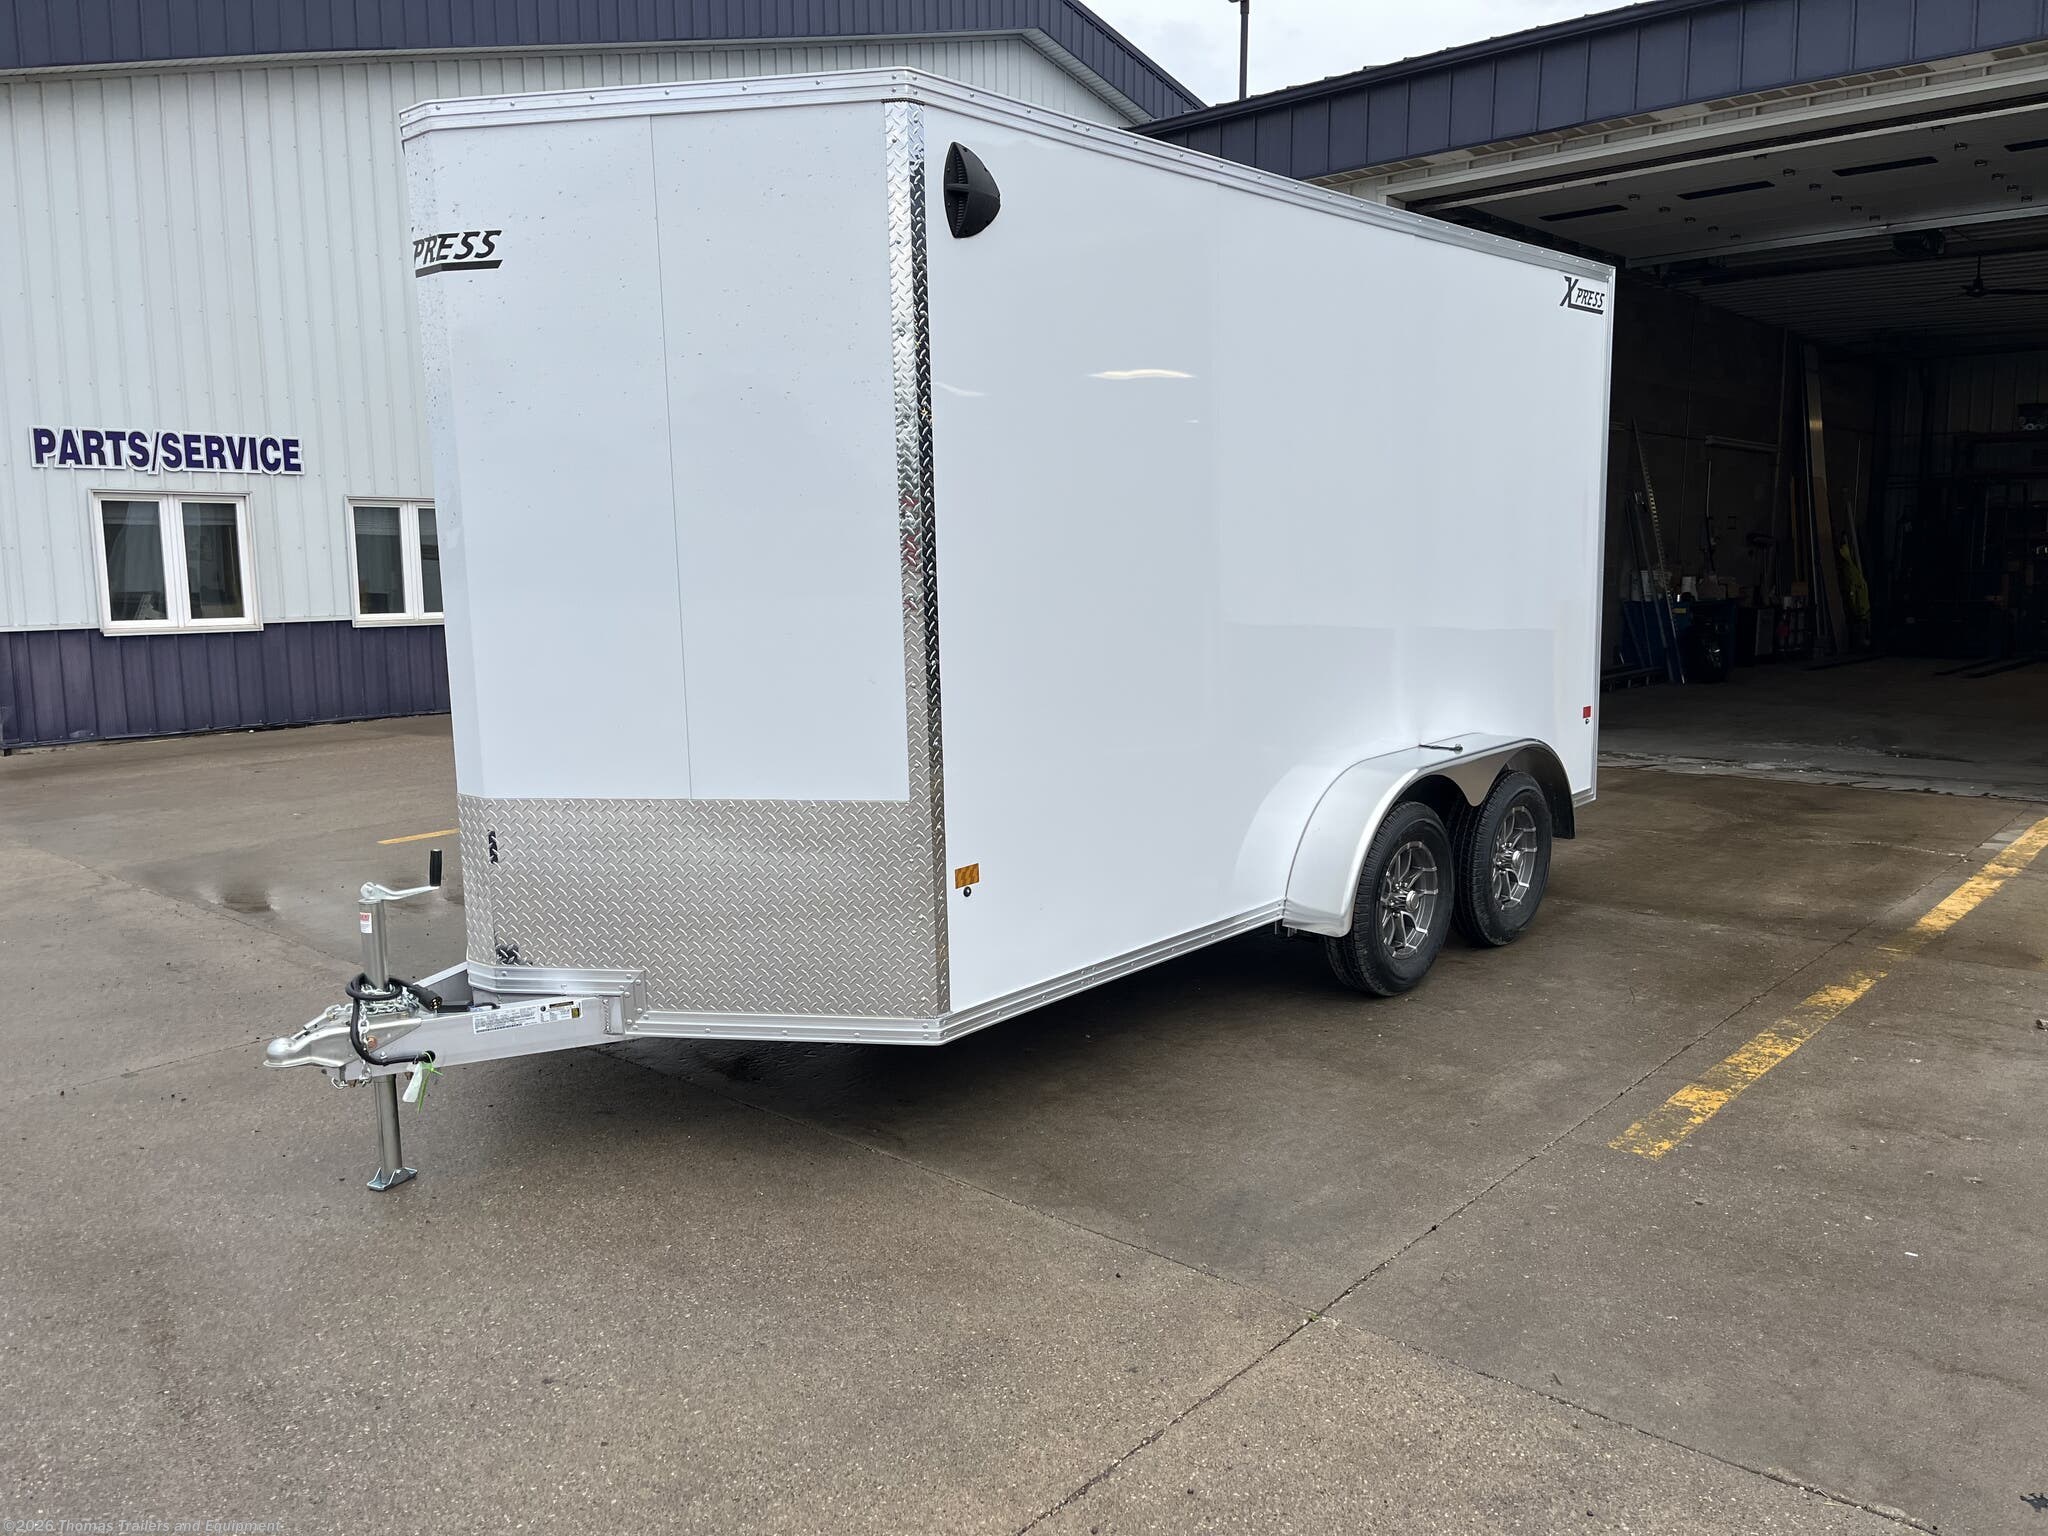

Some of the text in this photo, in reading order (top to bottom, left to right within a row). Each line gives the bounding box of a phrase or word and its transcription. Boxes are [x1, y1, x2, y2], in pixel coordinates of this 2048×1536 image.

[413, 230, 502, 267] PRESS
[1560, 275, 1605, 309] XPRESS
[32, 427, 302, 472] PARTS/SERVICE
